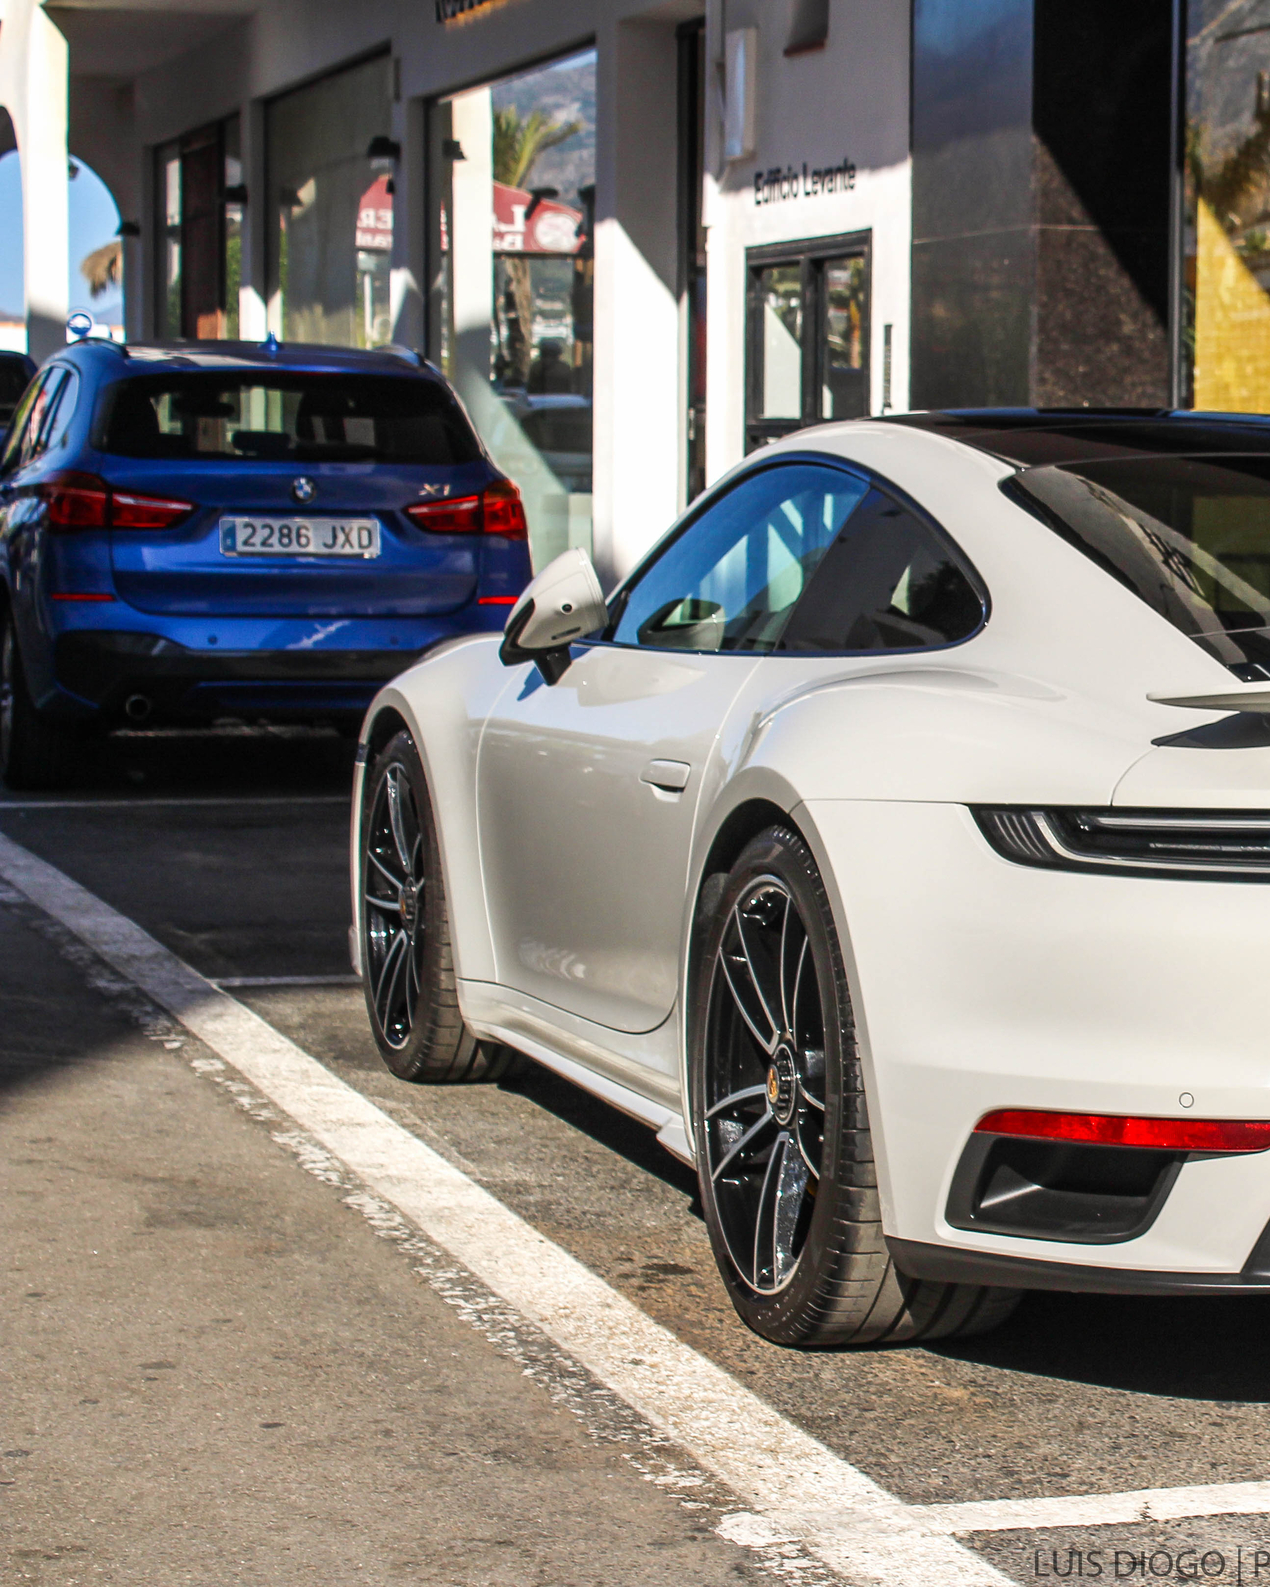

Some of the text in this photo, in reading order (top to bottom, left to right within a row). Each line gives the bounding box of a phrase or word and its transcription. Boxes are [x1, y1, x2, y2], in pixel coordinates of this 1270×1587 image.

[755, 157, 856, 207] Edificio Levante
[241, 523, 373, 550] 2286 JXD
